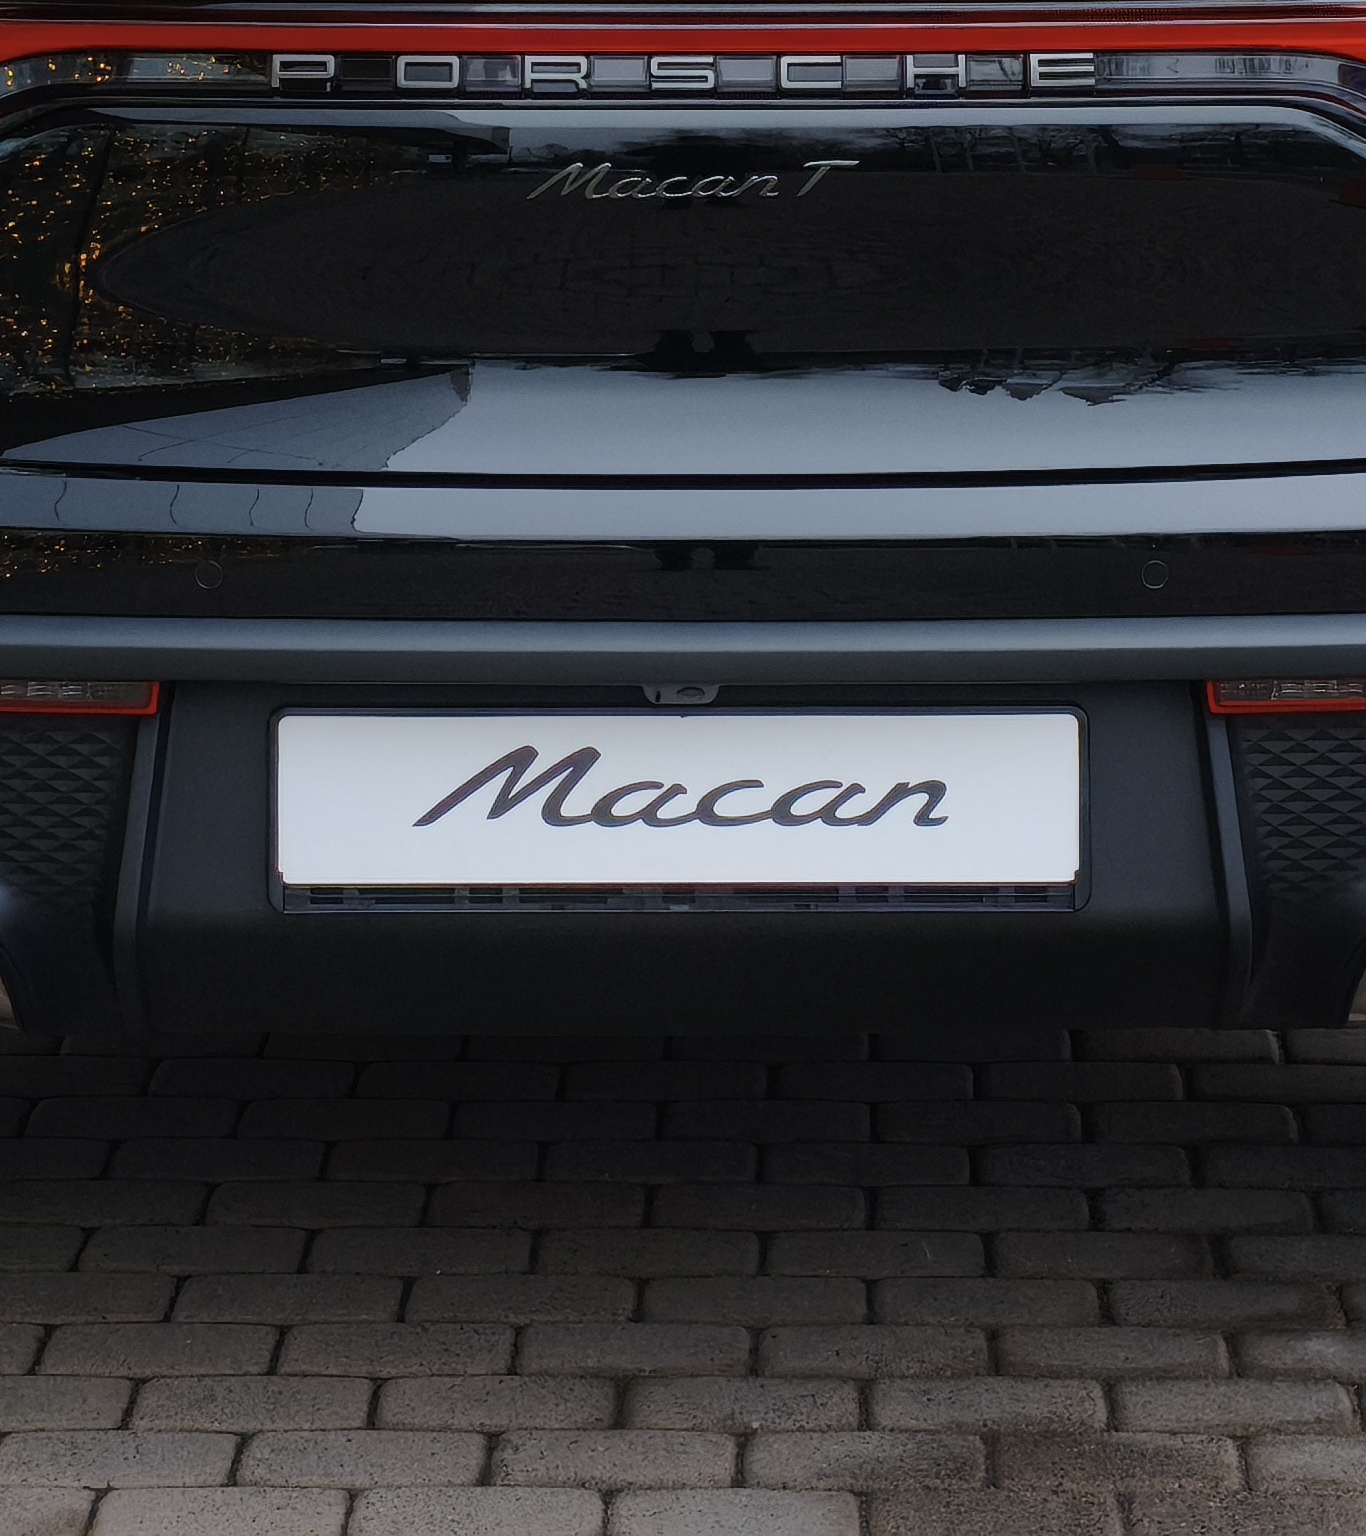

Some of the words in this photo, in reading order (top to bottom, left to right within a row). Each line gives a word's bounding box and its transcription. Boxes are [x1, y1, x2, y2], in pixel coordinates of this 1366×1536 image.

[271, 52, 1096, 90] PORSCHE
[526, 161, 780, 200] Macan
[795, 159, 861, 198] T
[411, 744, 950, 828] Macan
